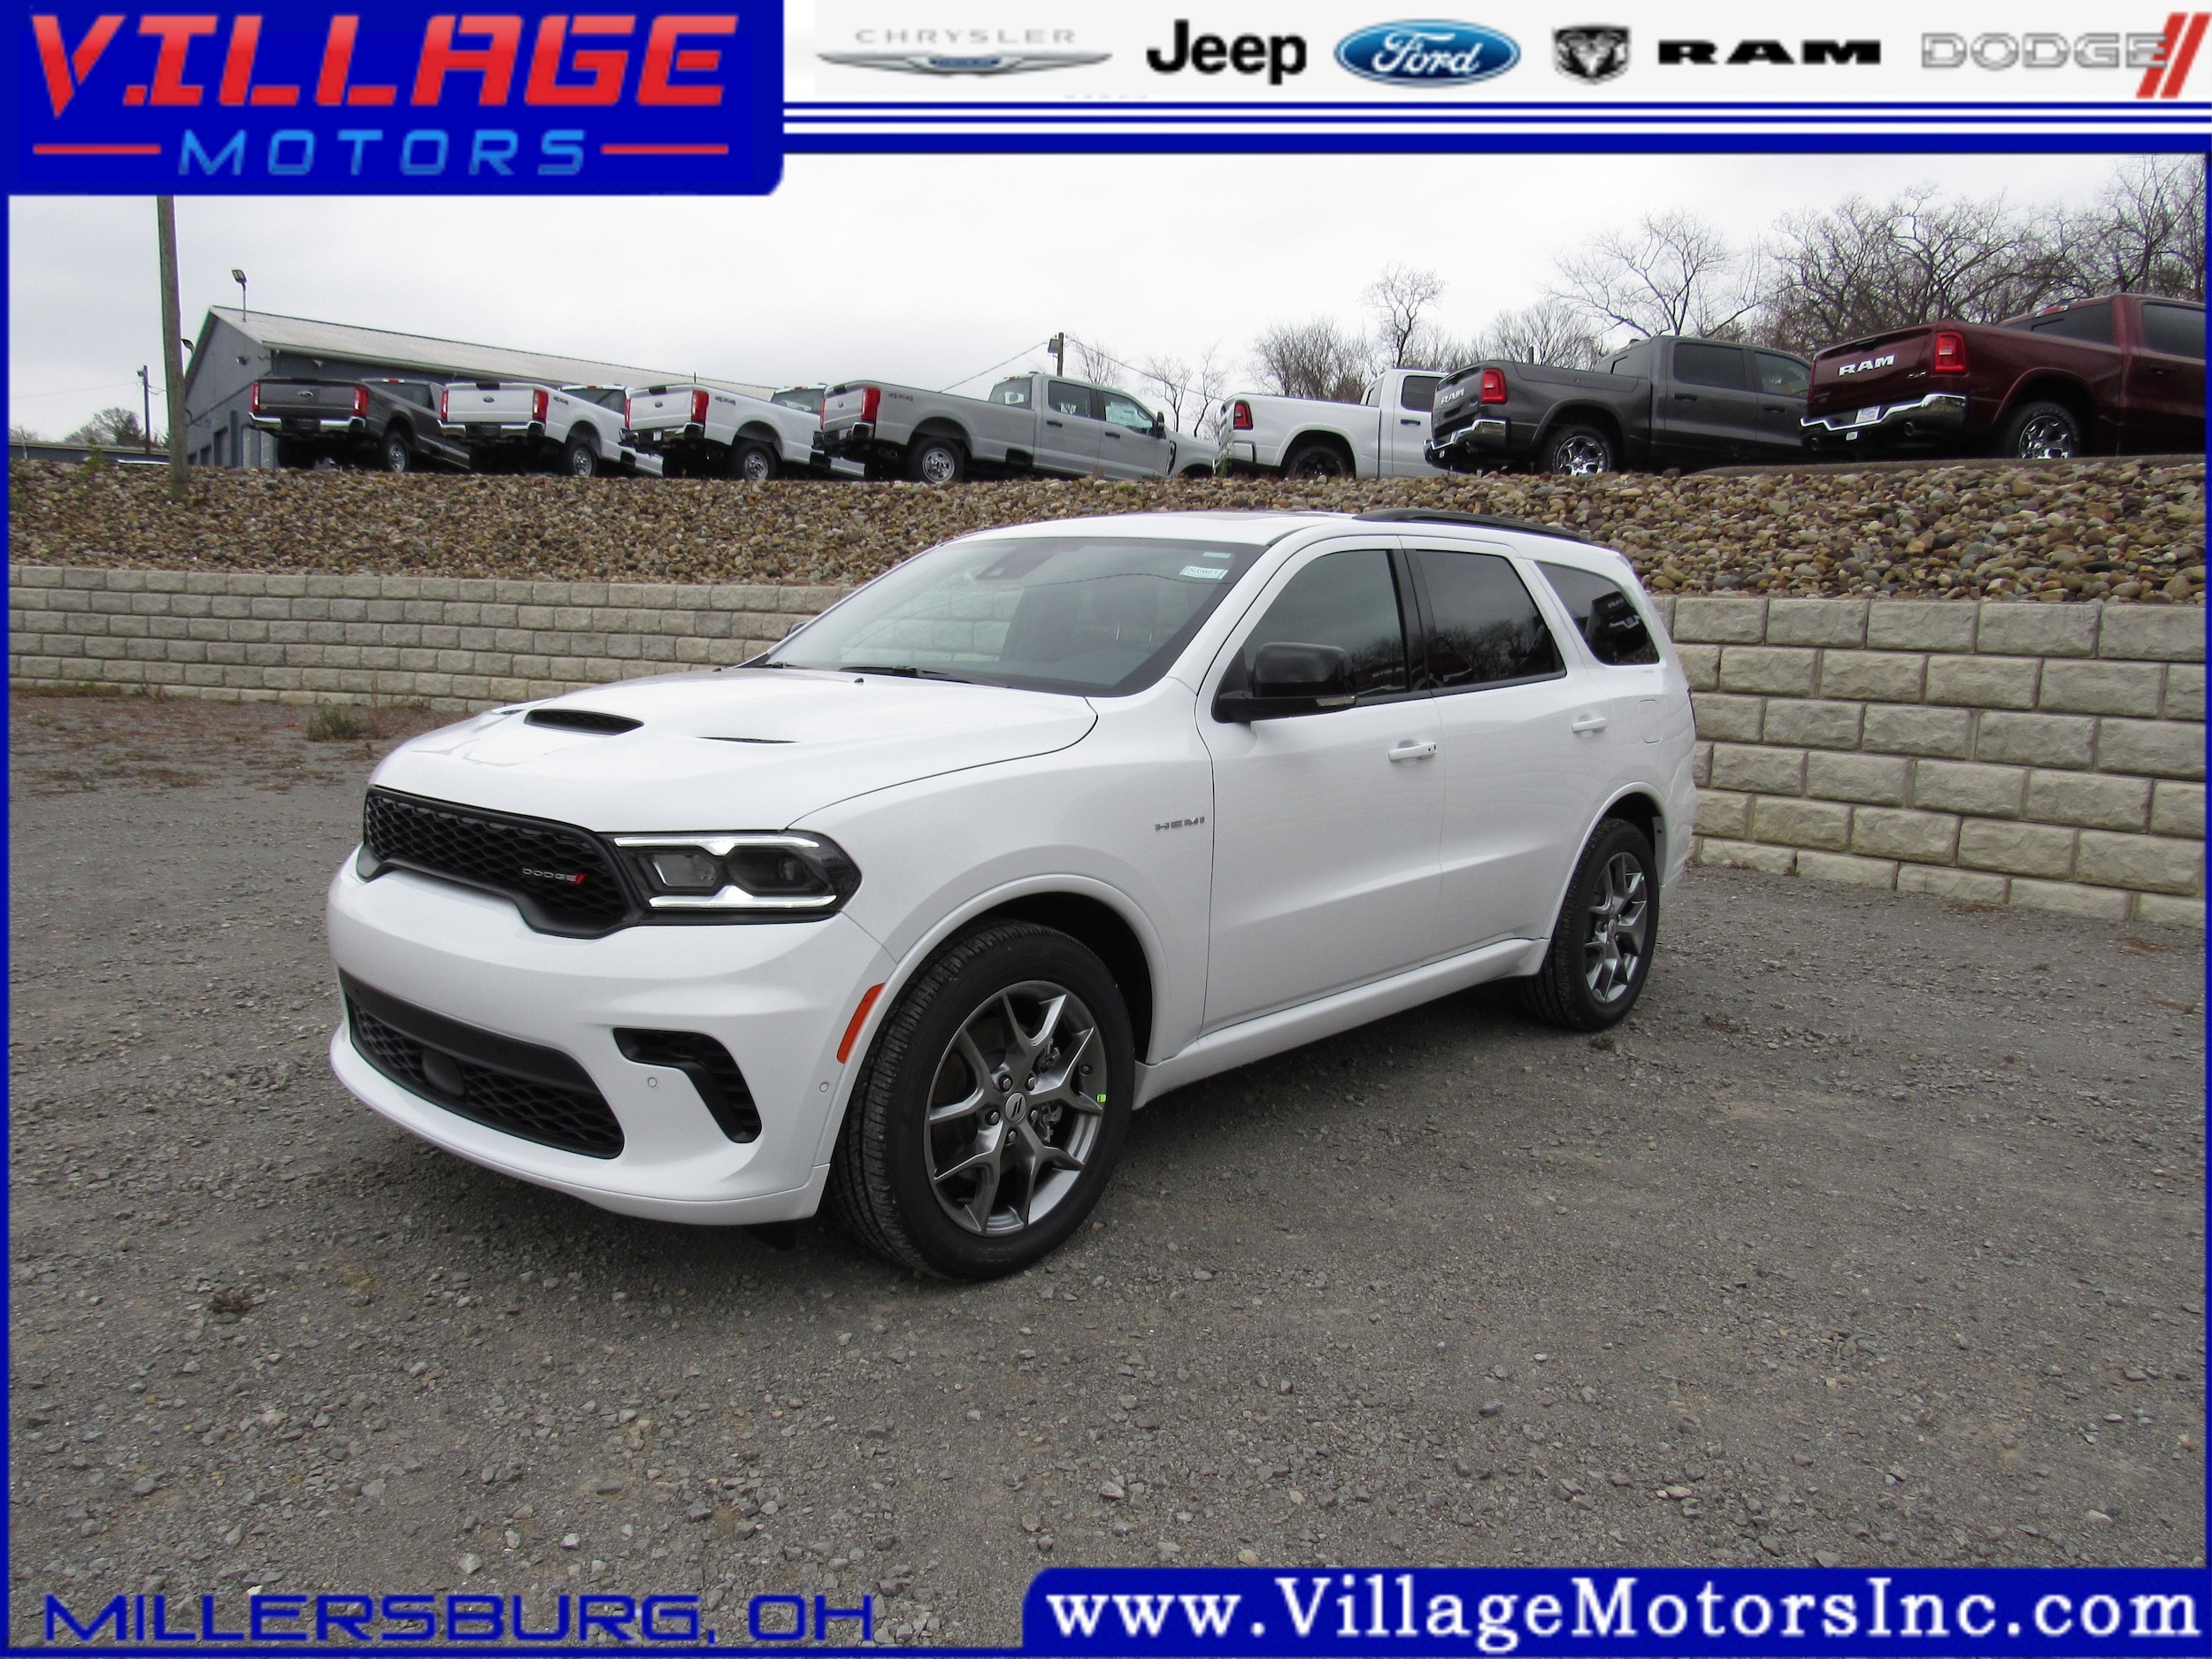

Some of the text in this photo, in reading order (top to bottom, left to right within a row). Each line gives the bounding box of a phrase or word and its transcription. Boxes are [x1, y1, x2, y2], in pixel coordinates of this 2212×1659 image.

[1839, 355, 1895, 377] RAM
[1440, 388, 1465, 405] RAM
[1154, 816, 1205, 832] HEMI
[523, 868, 577, 881] DODGE
